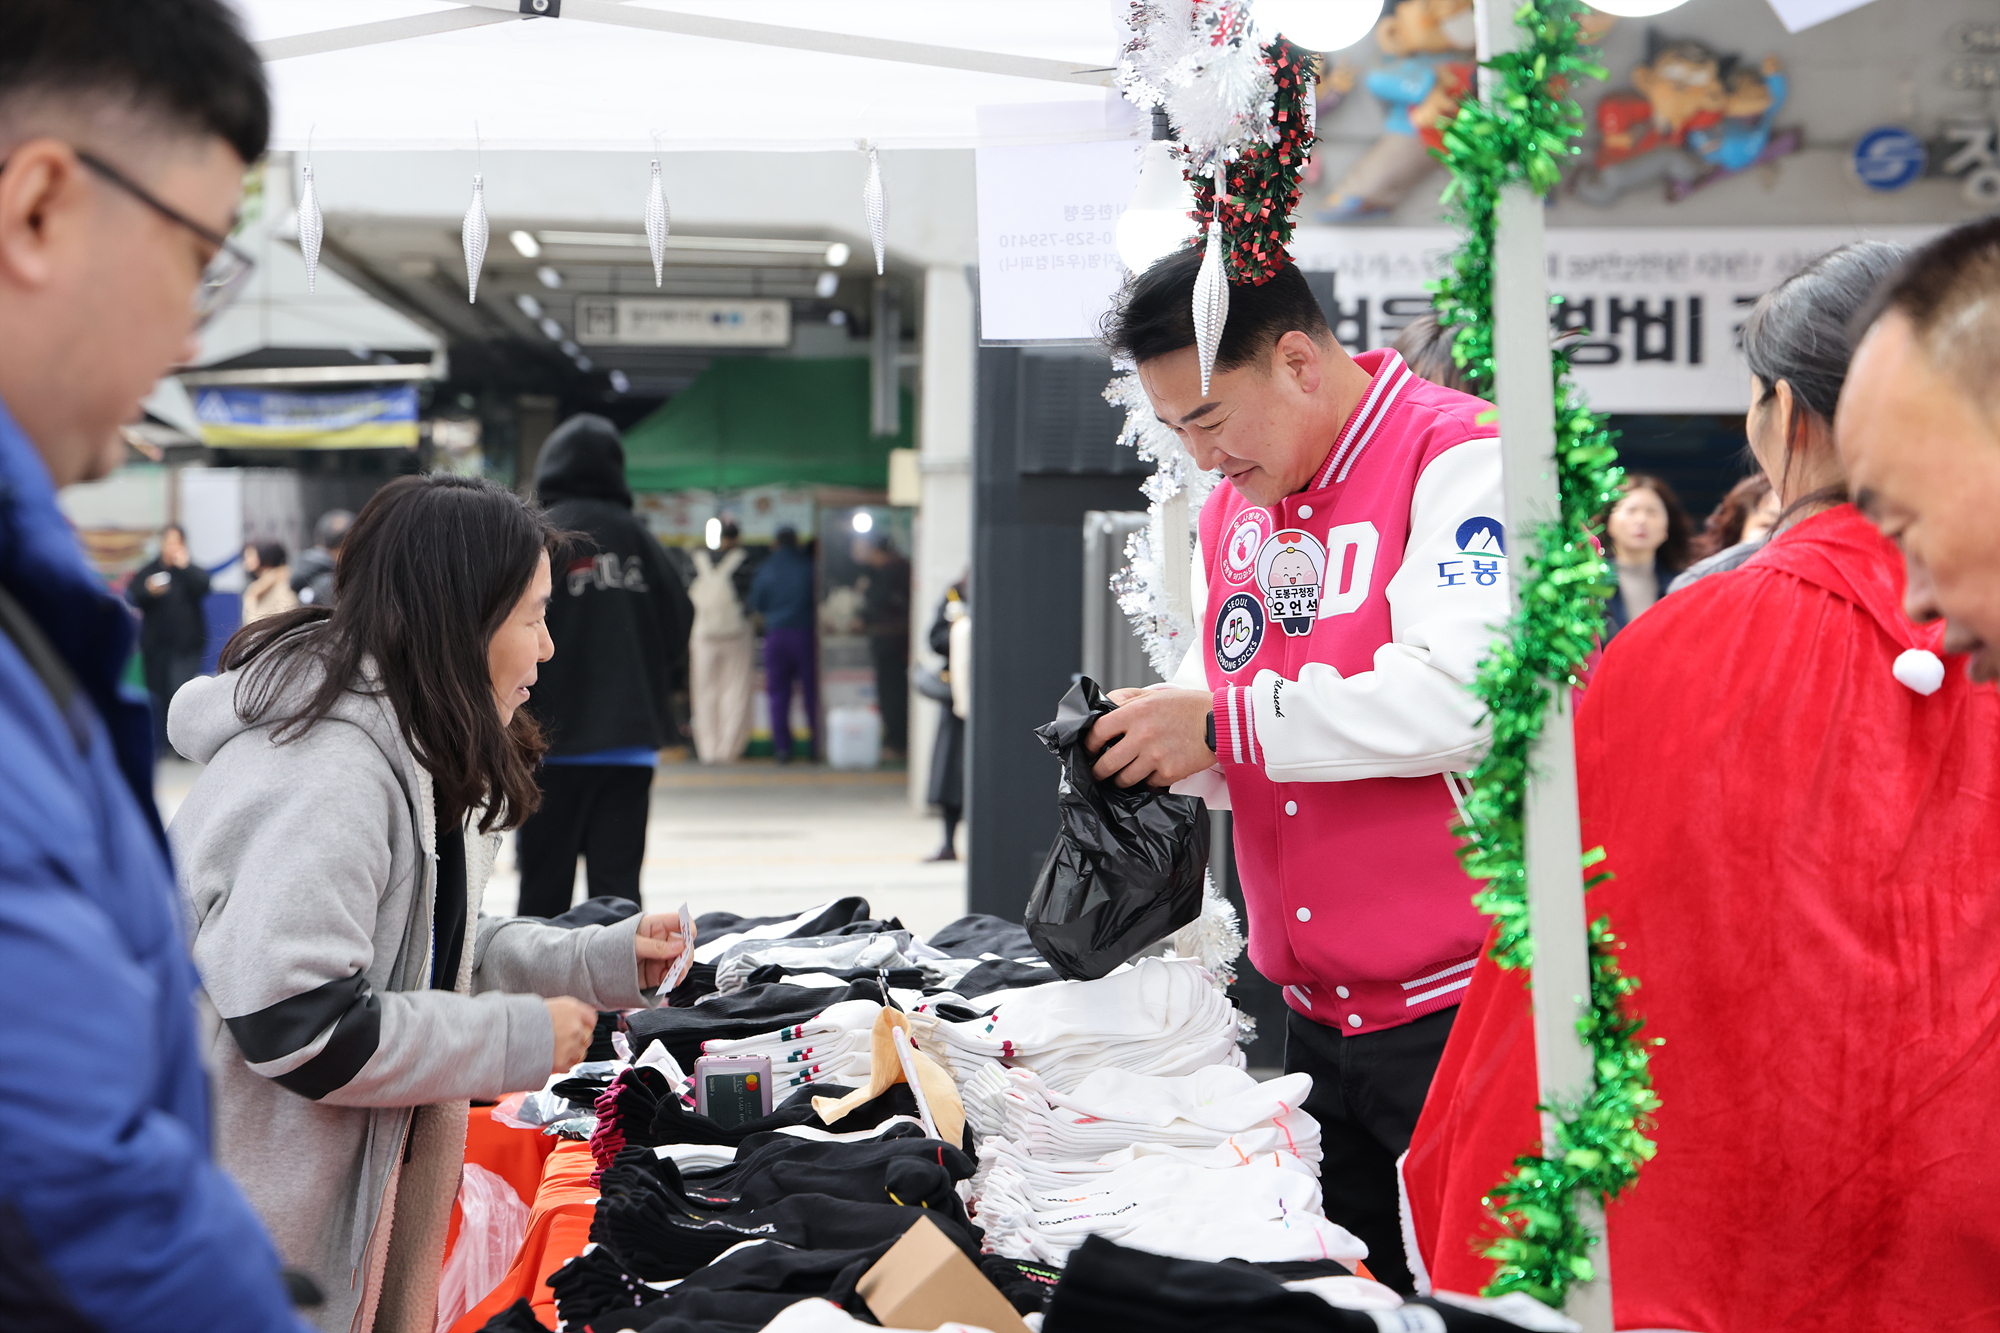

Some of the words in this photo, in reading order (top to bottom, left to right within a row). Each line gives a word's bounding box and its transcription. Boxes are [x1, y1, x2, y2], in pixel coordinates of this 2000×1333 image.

[1550, 294, 1704, 366] 방비
[1317, 520, 1380, 620] D
[1437, 560, 1509, 587] 도봉
[1227, 598, 1248, 612] SEOUL
[1275, 587, 1315, 599] 도봉구청장
[1217, 649, 1237, 670] DOBONG
[1237, 640, 1258, 666] SOCKS
